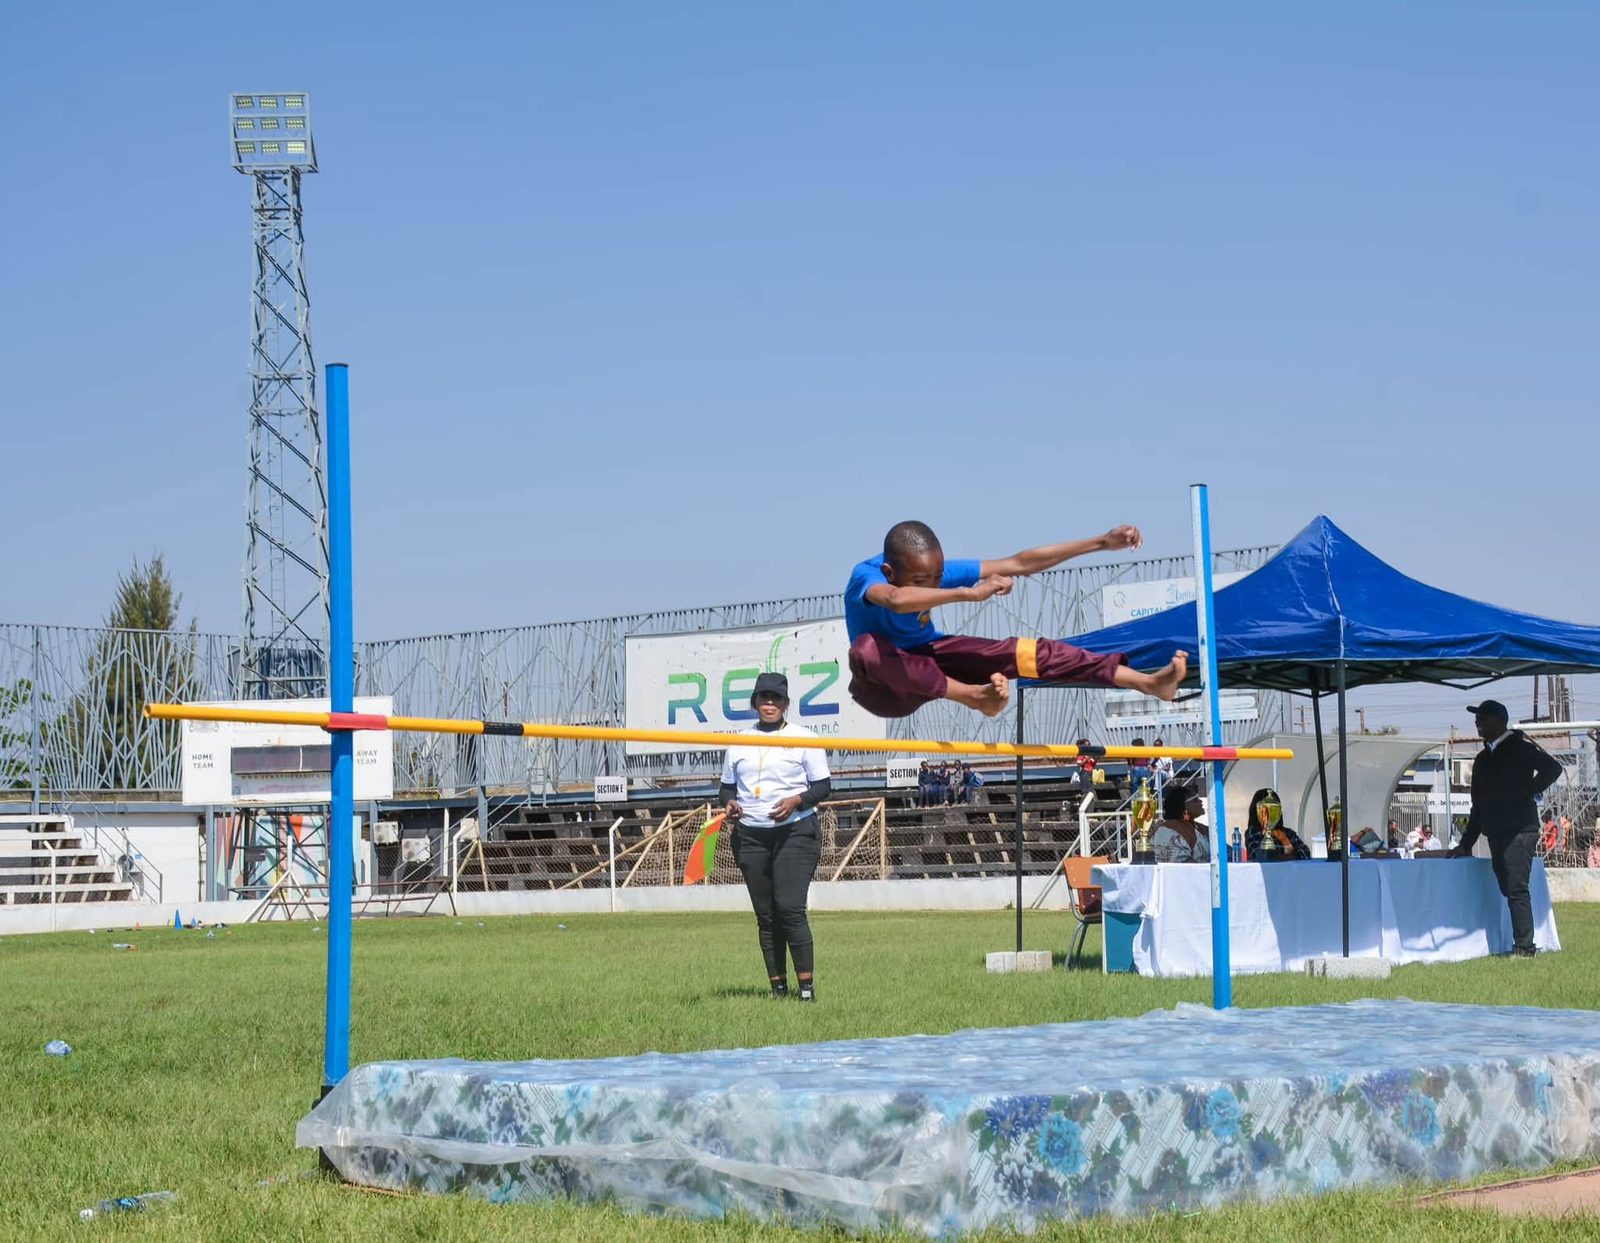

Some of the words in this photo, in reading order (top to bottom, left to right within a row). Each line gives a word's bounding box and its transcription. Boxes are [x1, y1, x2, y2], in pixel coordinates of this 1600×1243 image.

[192, 753, 213, 761] HOME
[889, 768, 918, 778] SECTION
[597, 784, 620, 794] SECTION
